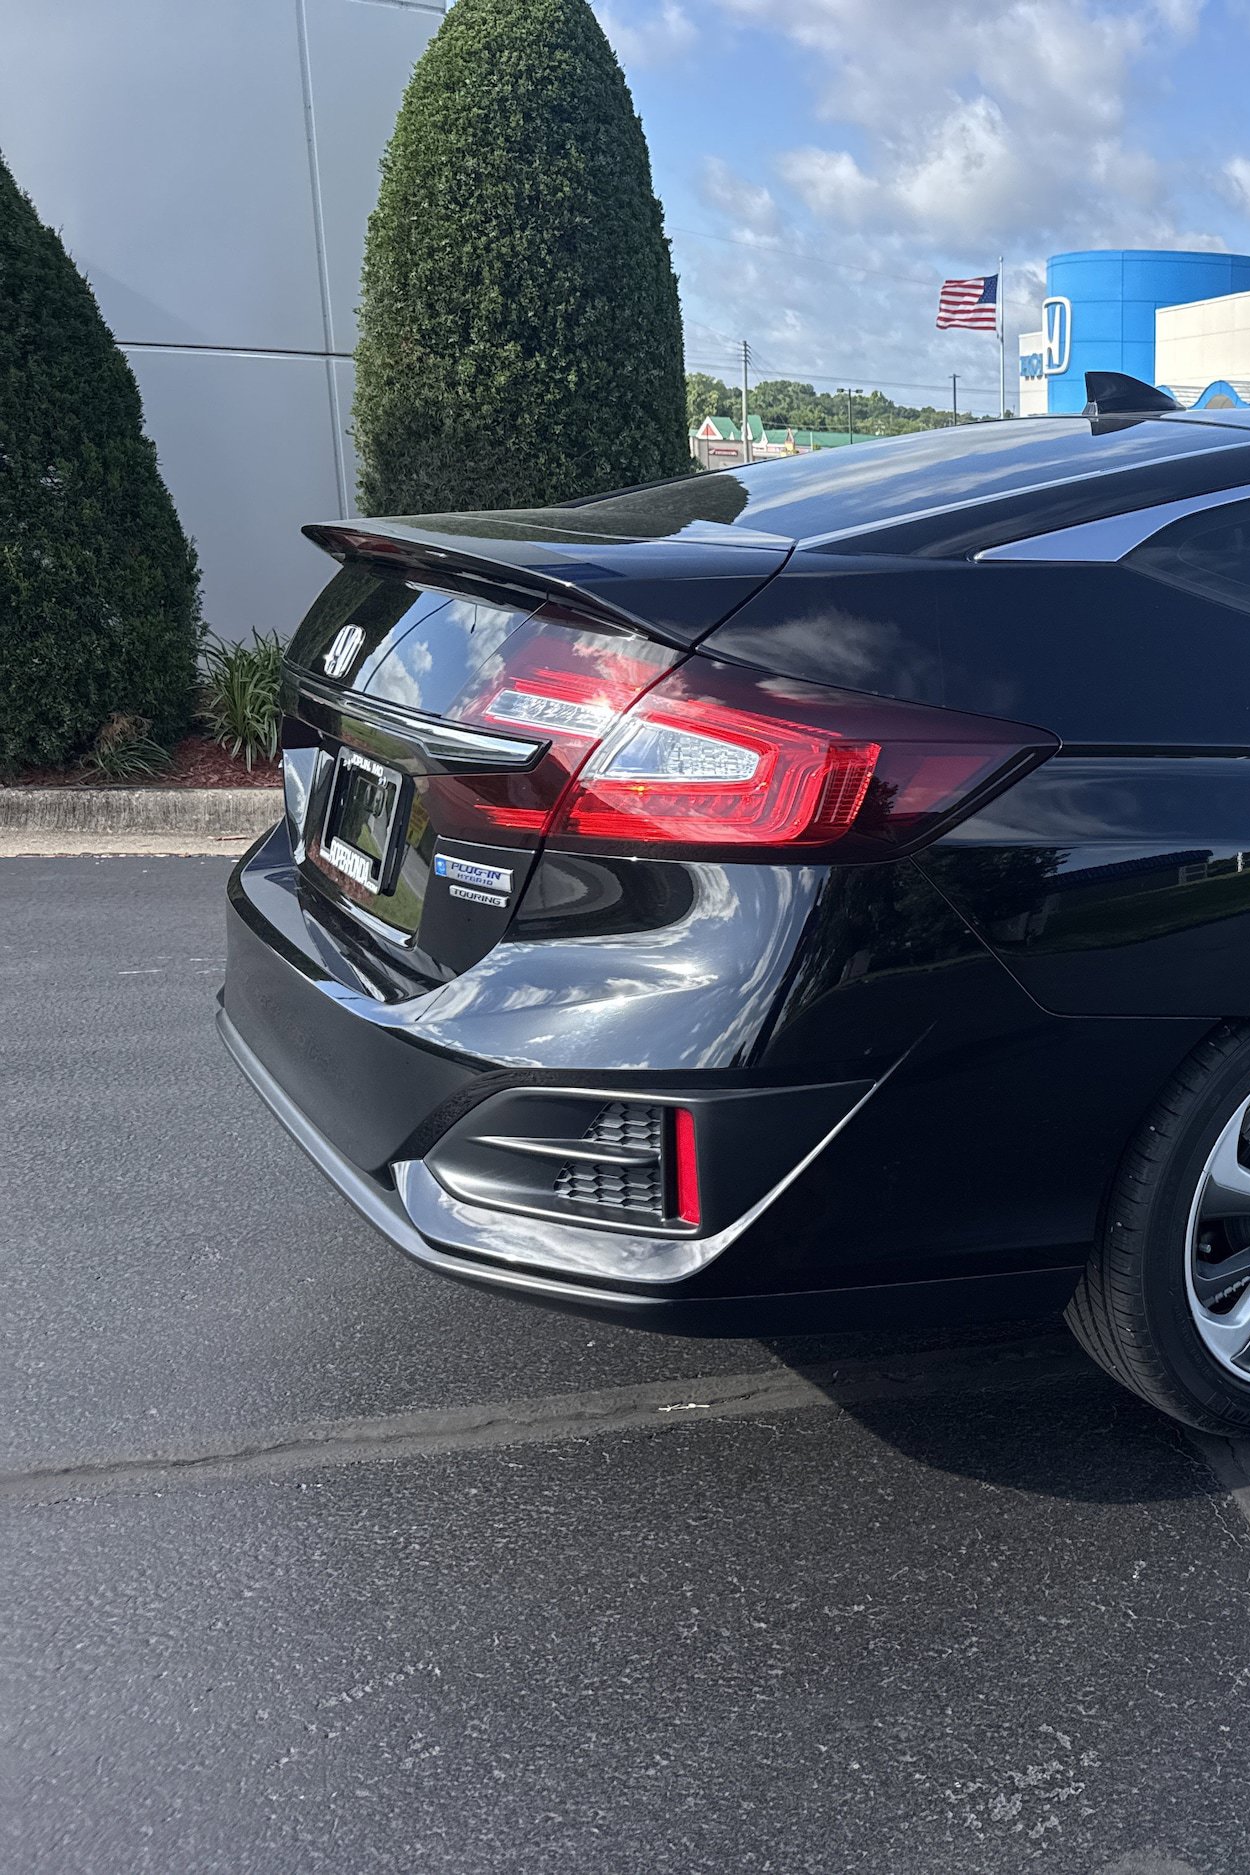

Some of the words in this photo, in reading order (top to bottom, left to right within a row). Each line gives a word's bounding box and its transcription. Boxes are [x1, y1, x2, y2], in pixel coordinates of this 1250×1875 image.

[371, 763, 384, 777] MO
[451, 862, 502, 880] PLUG-IN
[457, 873, 493, 887] HYBRID
[453, 888, 502, 906] TOURING
